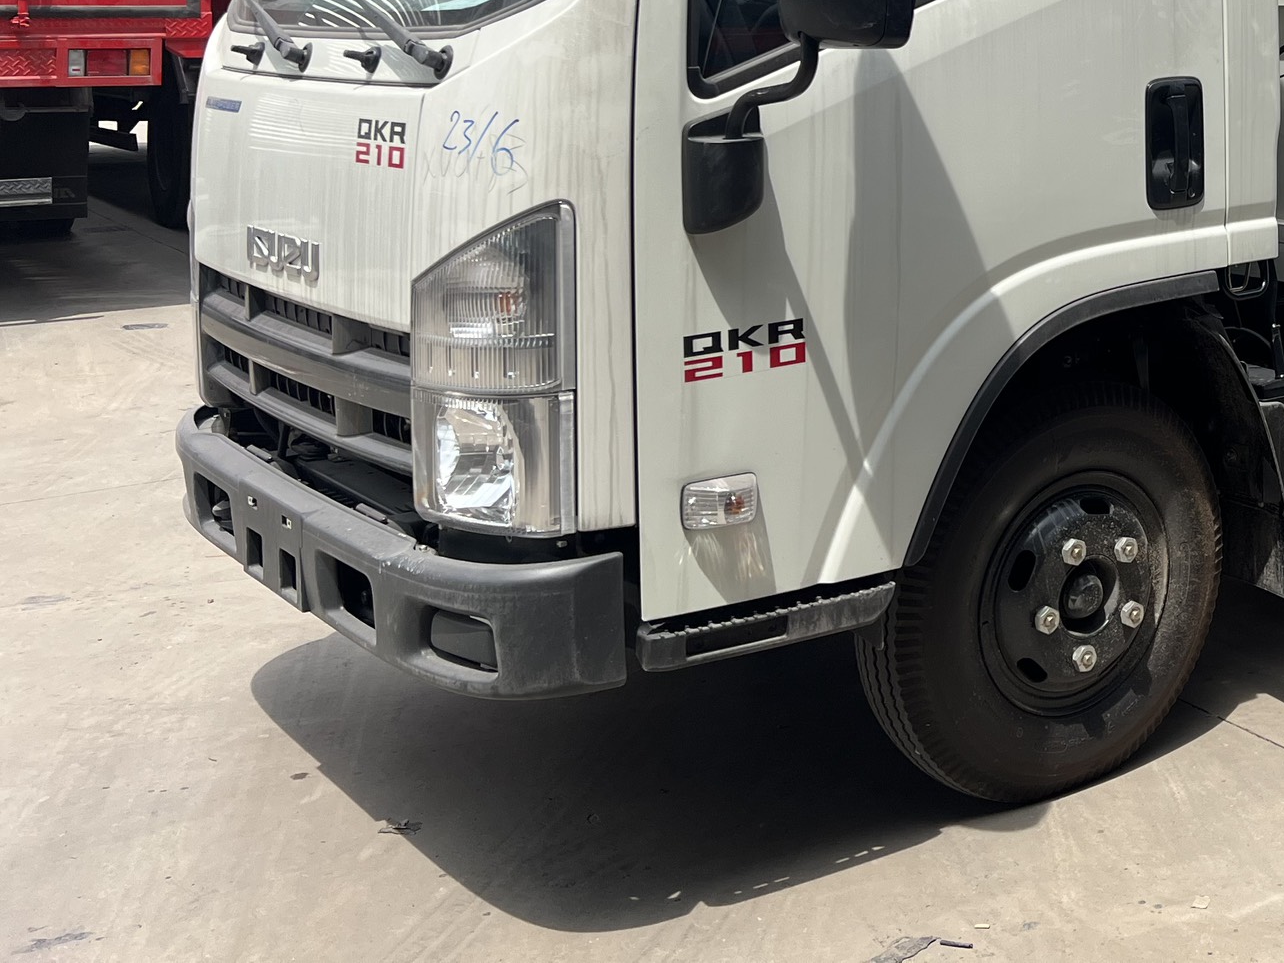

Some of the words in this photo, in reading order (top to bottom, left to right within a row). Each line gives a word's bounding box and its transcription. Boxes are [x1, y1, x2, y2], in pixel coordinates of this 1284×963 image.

[357, 118, 407, 144] QKR
[442, 110, 520, 177] 23/6
[355, 142, 405, 169] 210
[246, 225, 321, 281] ISUZU
[682, 317, 806, 358] QKR
[683, 342, 806, 383] 210
